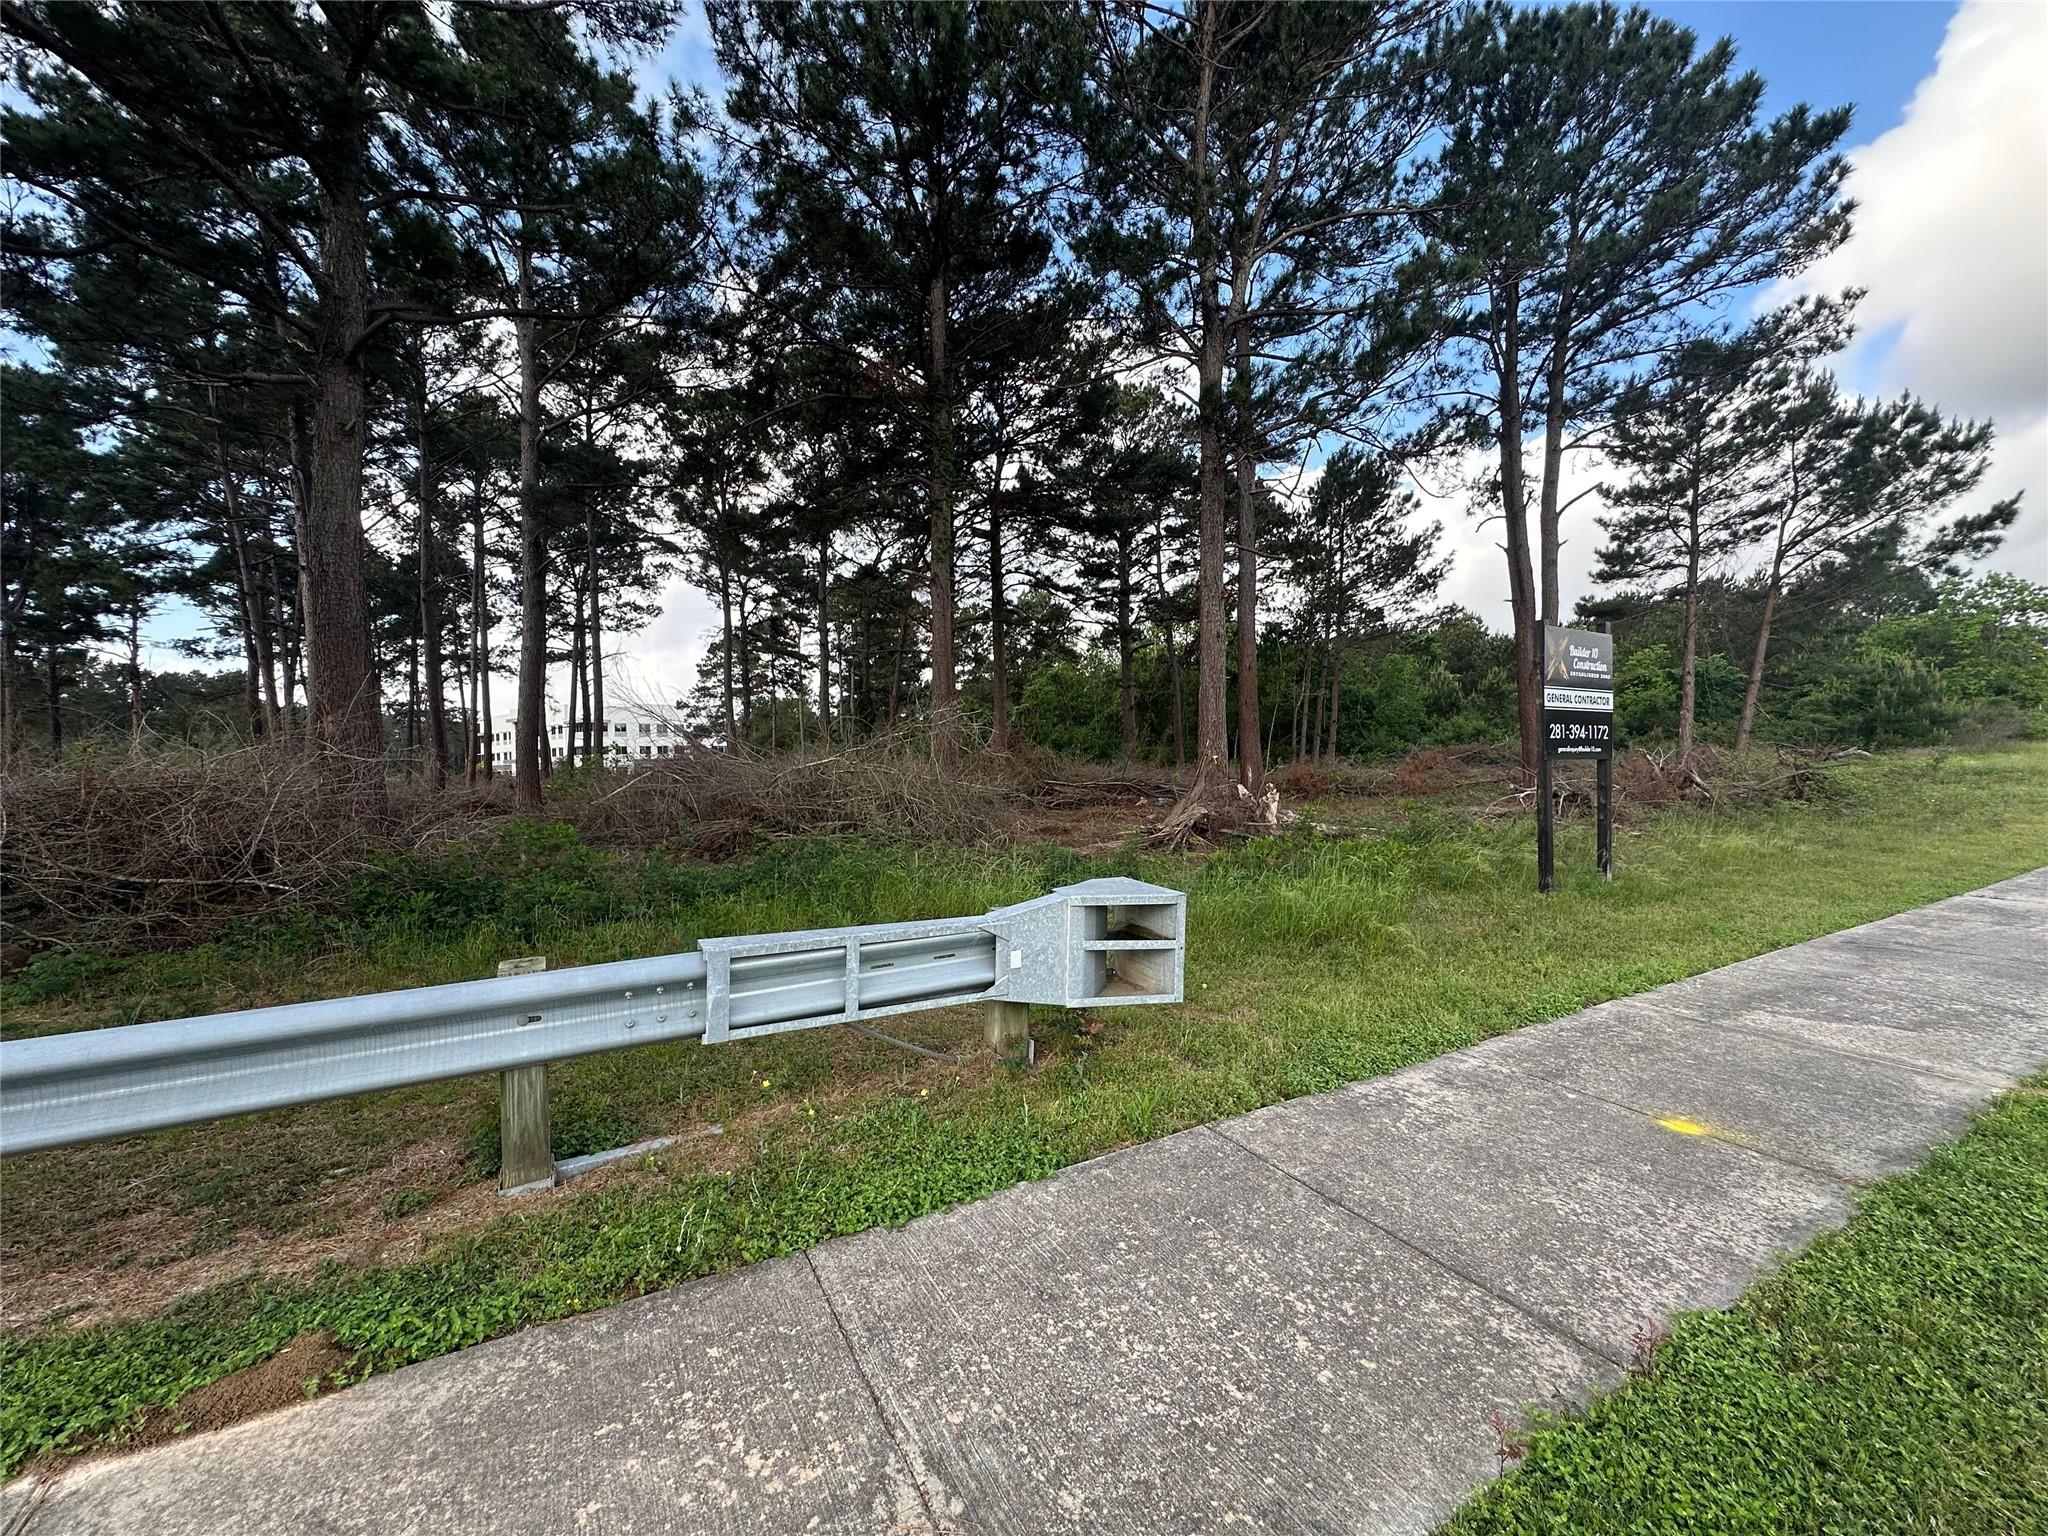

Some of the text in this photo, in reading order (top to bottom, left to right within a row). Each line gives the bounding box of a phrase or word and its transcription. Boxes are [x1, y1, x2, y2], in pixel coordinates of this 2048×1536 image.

[1569, 645, 1599, 659] Builder 10
[1573, 657, 1608, 672] Construction
[1546, 692, 1610, 706] GENERAL CONTRACTOR
[1549, 723, 1609, 740] 281-394-1172
